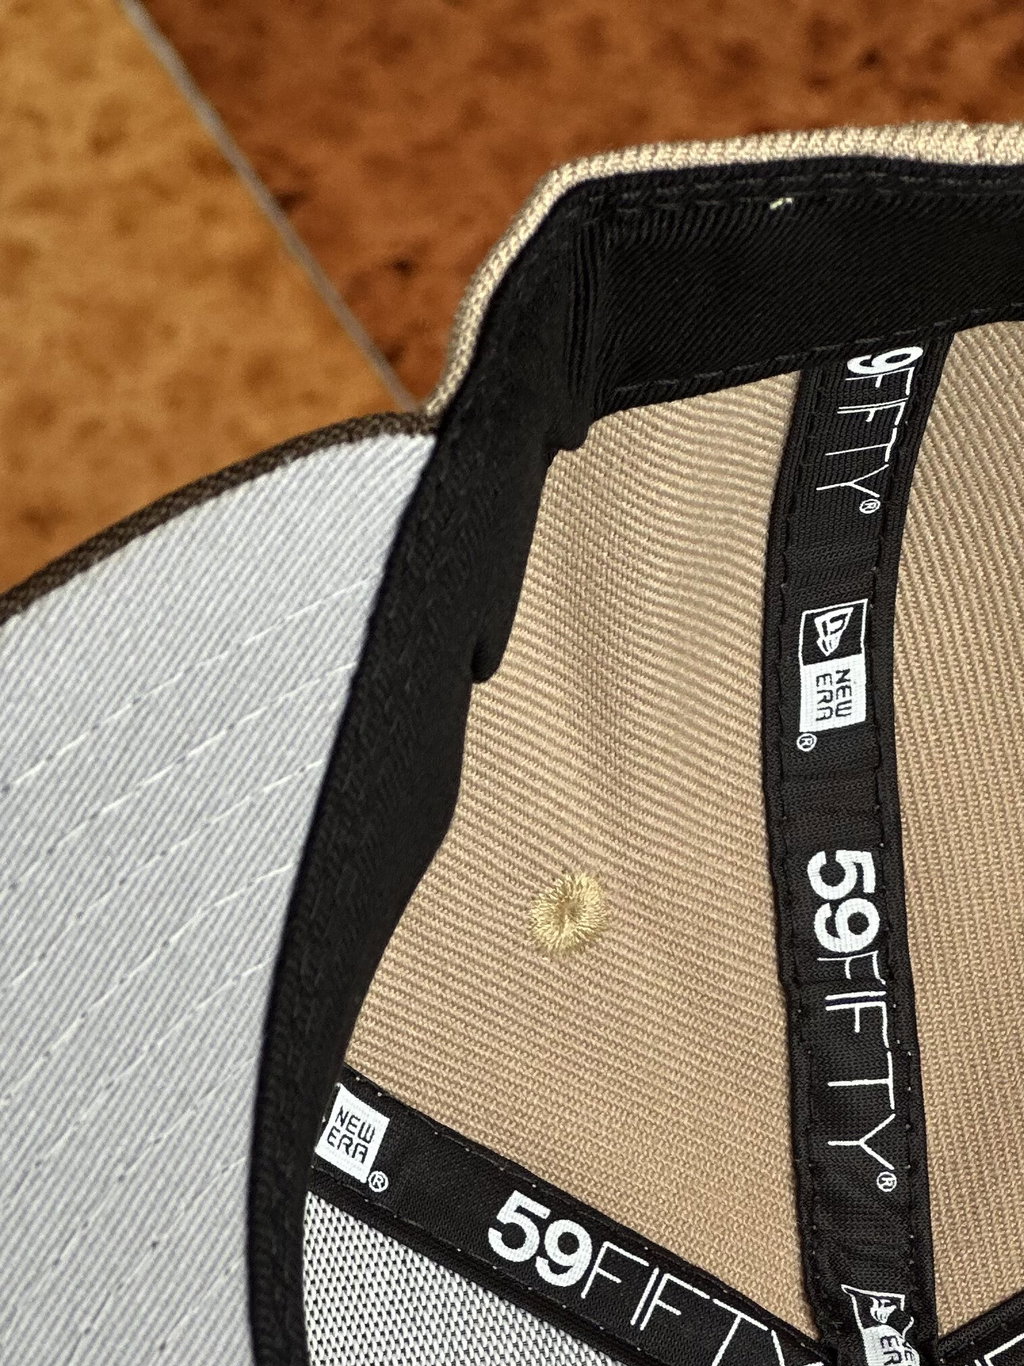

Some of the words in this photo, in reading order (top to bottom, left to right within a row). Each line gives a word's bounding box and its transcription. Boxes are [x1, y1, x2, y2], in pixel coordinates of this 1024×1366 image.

[815, 673, 834, 721] ERA
[835, 668, 852, 717] NEW
[327, 1126, 369, 1164] ERA
[335, 1105, 376, 1144] NEW
